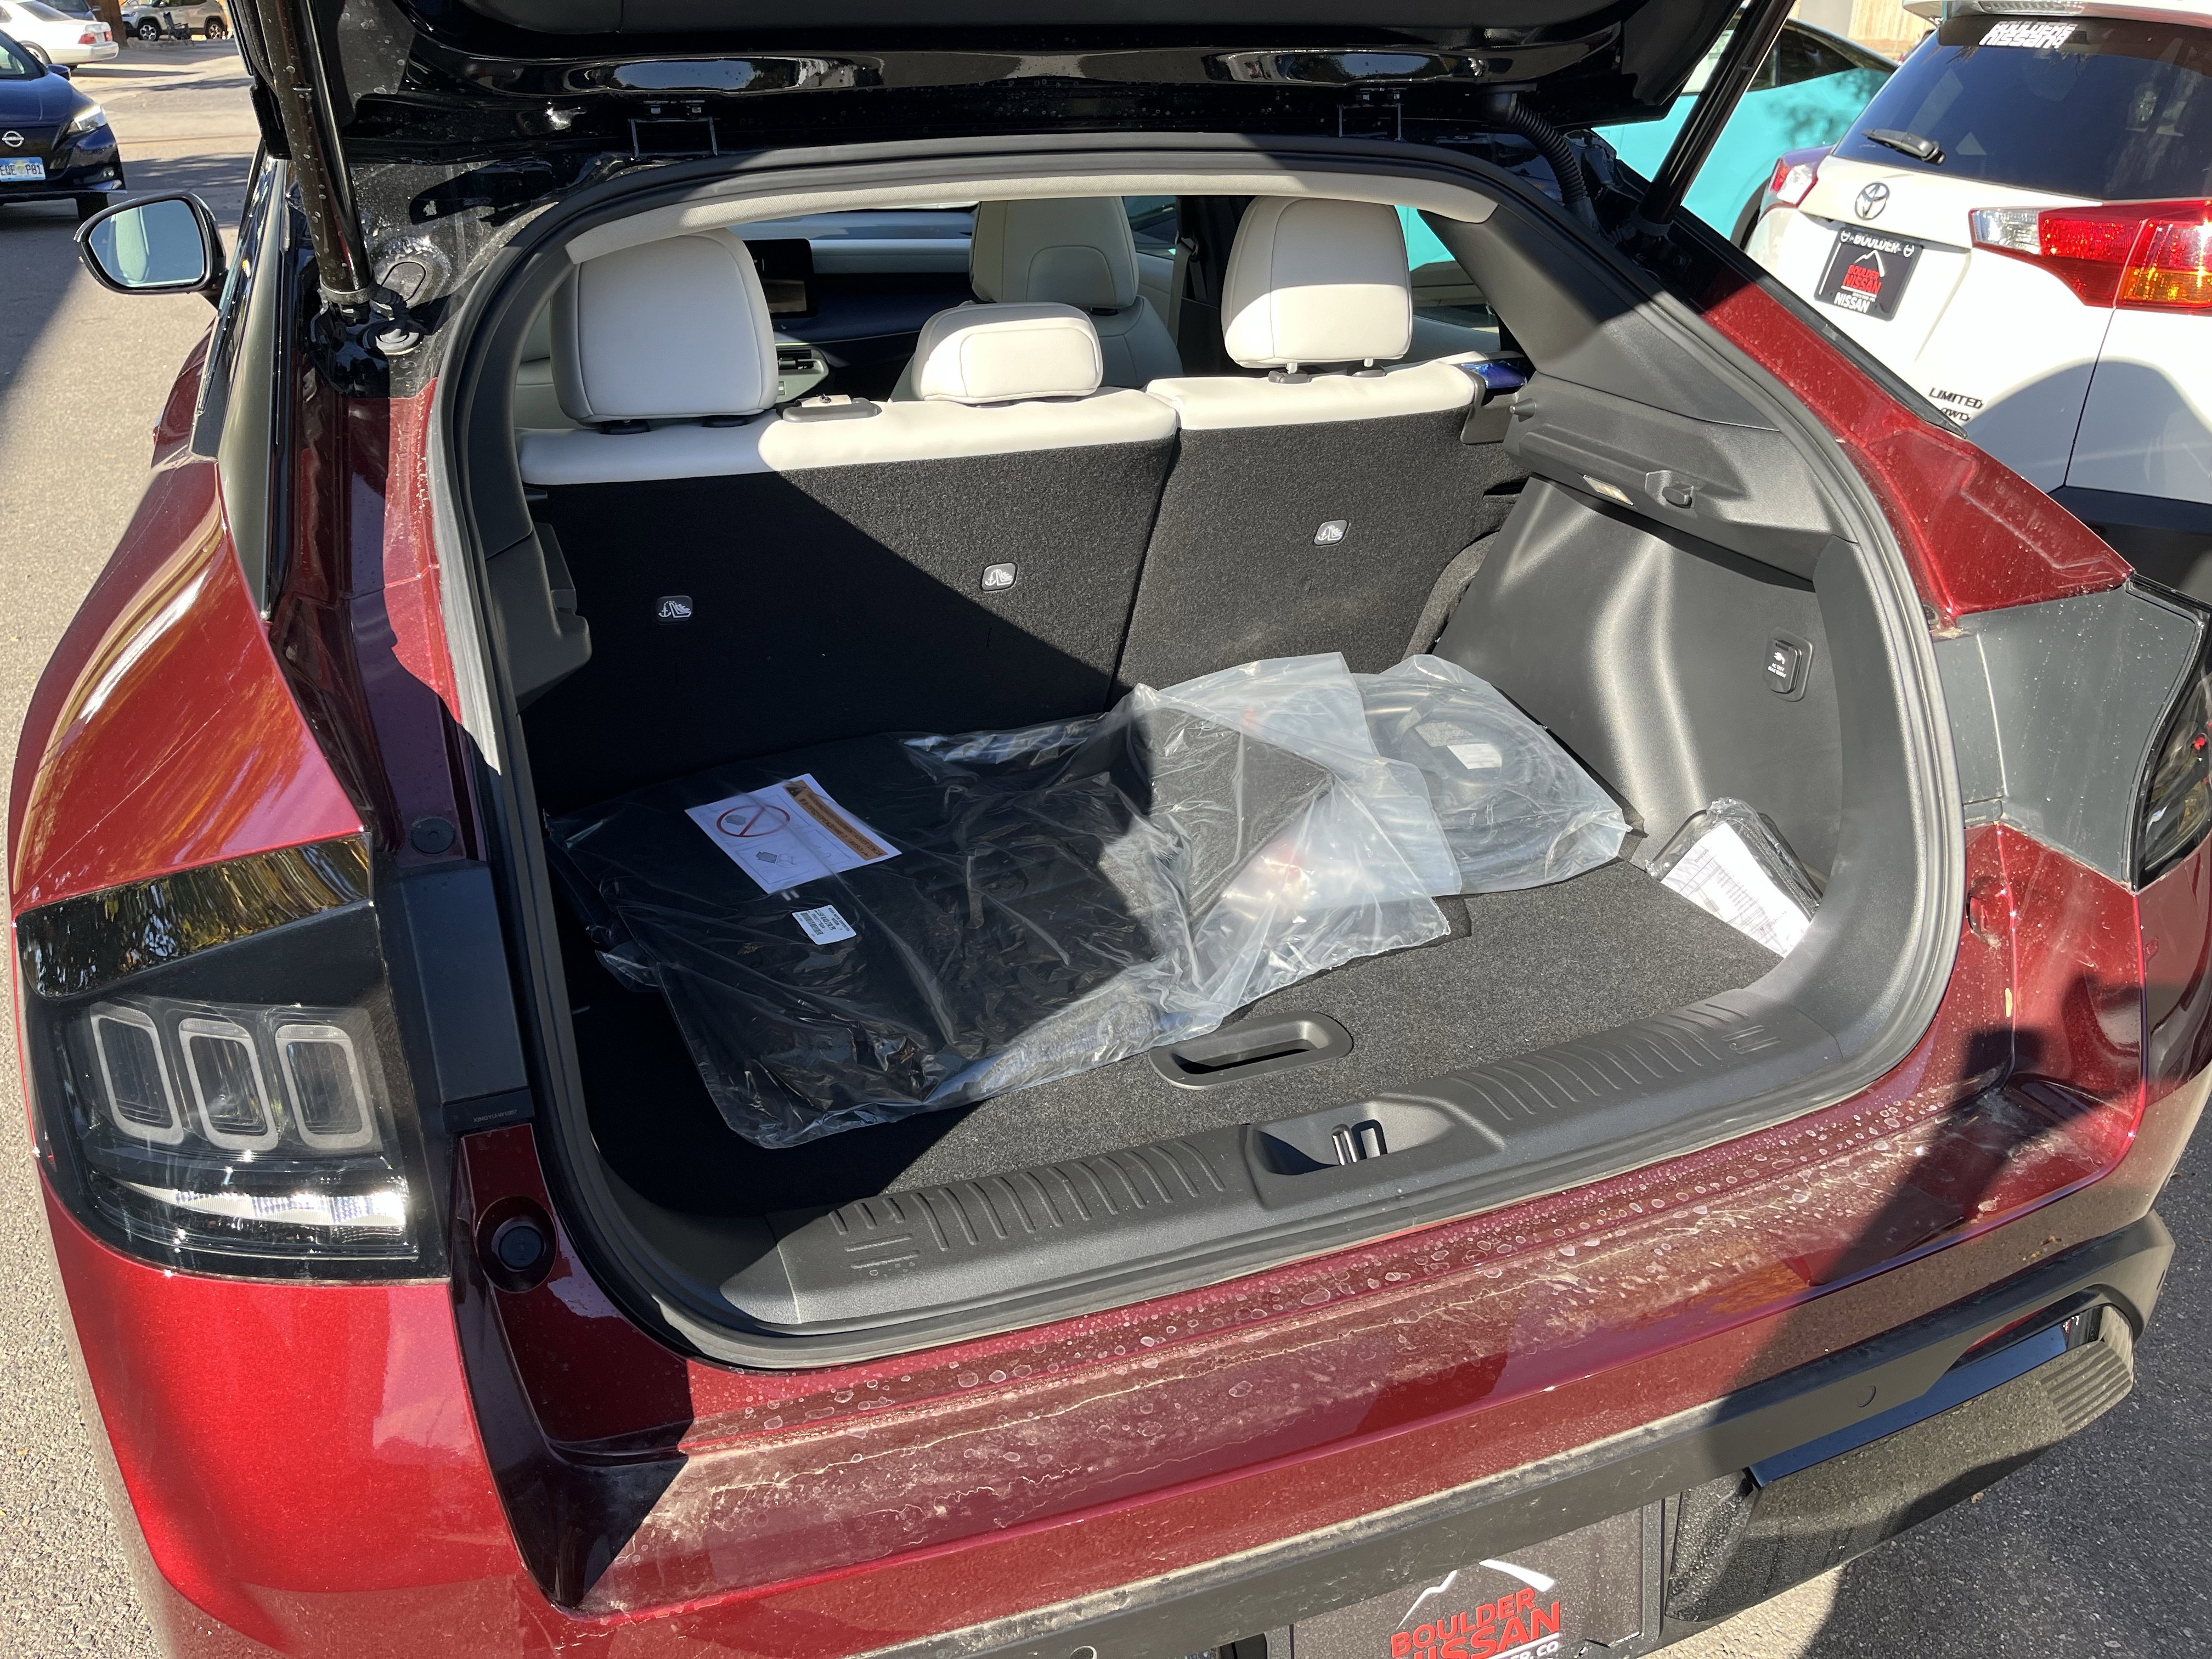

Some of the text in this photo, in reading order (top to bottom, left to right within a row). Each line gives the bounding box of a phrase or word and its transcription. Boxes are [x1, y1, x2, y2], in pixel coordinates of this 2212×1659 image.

[1853, 233, 1901, 253] BOULDER
[1847, 264, 1880, 281] BOULDER
[1843, 274, 1882, 295] NISSAN
[1833, 292, 1871, 313] NISSAN
[1928, 387, 1984, 409] LIMITED
[1391, 1588, 1535, 1657] BOULDER
[1537, 1640, 1559, 1657] CO
